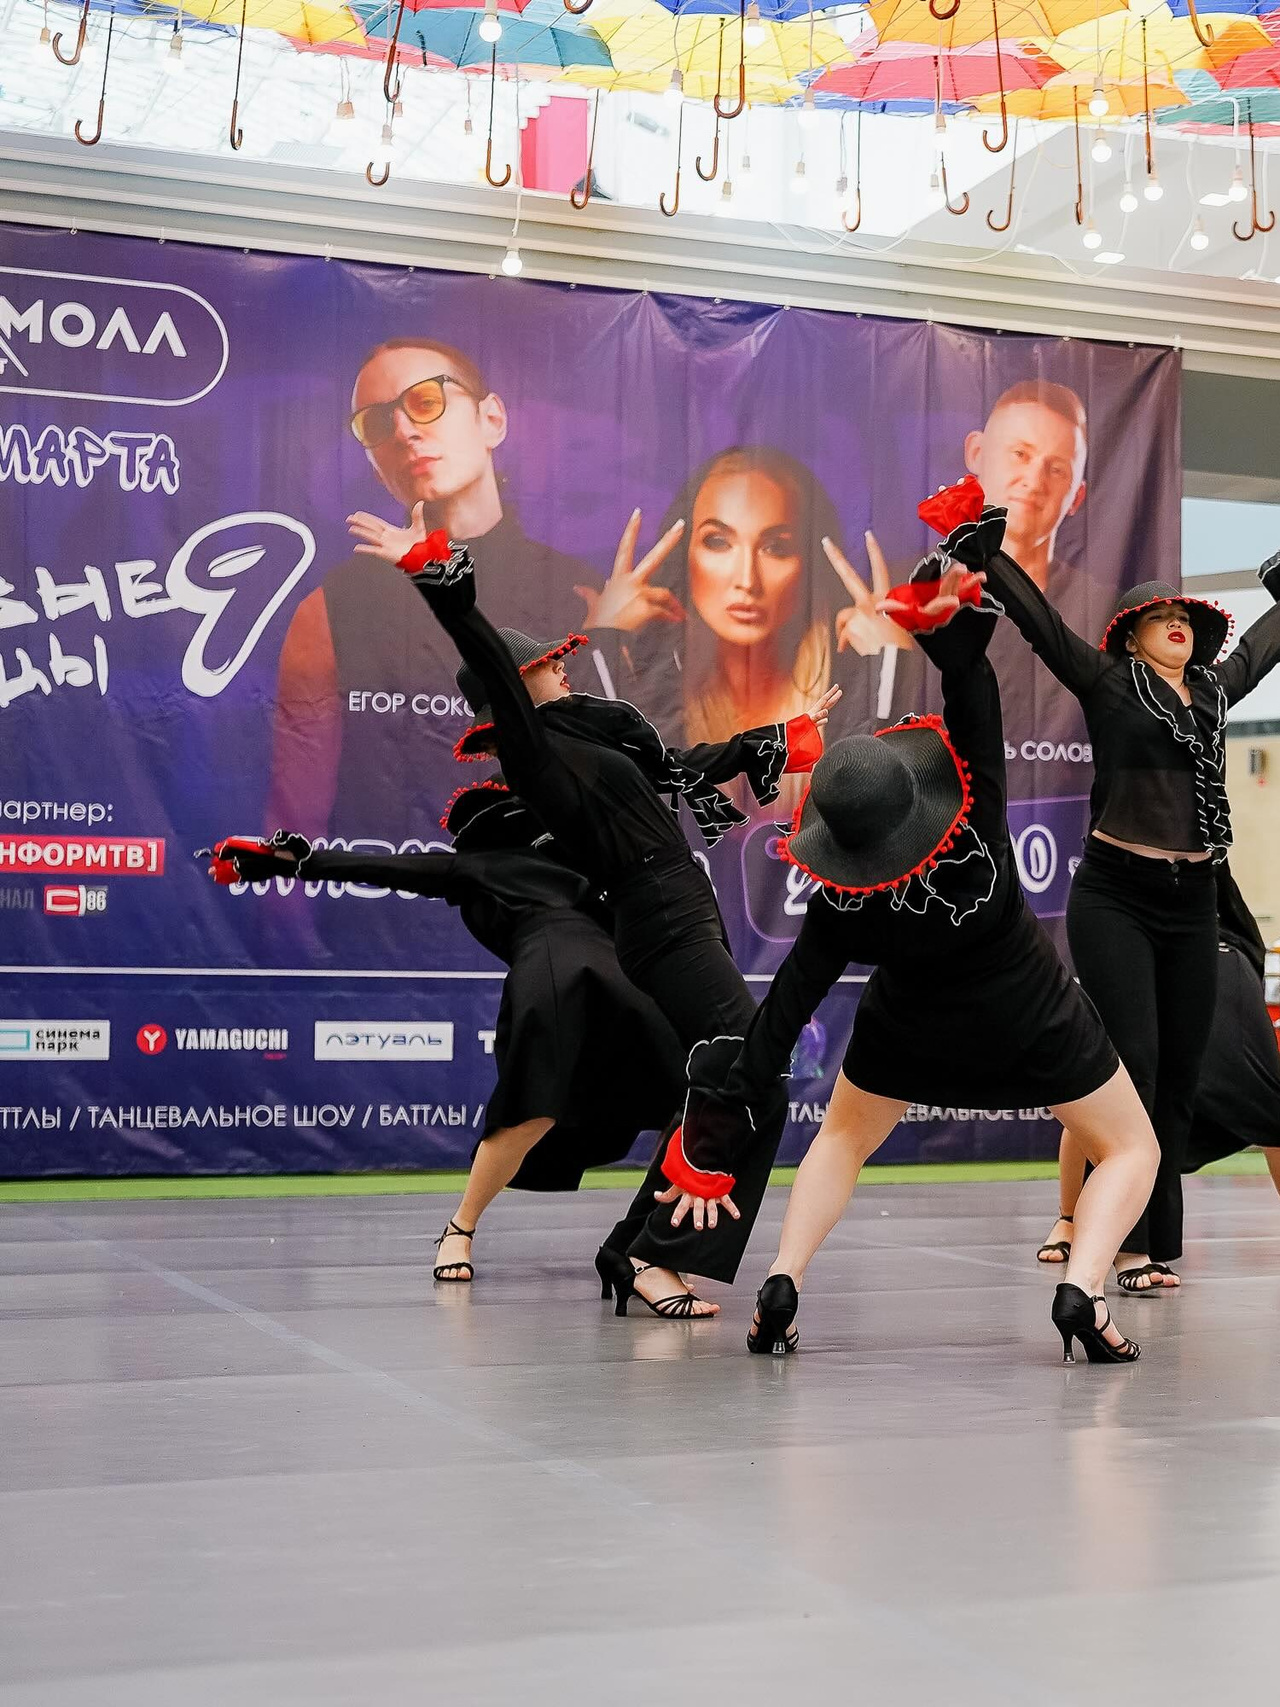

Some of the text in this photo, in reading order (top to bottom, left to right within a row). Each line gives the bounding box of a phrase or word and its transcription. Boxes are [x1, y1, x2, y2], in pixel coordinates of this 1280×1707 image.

[349, 690, 406, 713] ЕГОР
[0, 800, 114, 826] артнер:
[36, 1029, 101, 1040] синема
[175, 1028, 289, 1050] YAMAGUCHI
[35, 1041, 80, 1054] парк
[87, 1104, 287, 1130] ТАНЦЕВАЛЬНОЕ
[293, 1104, 355, 1127] ШОУ
[379, 1104, 467, 1127] БАТТЛЫ
